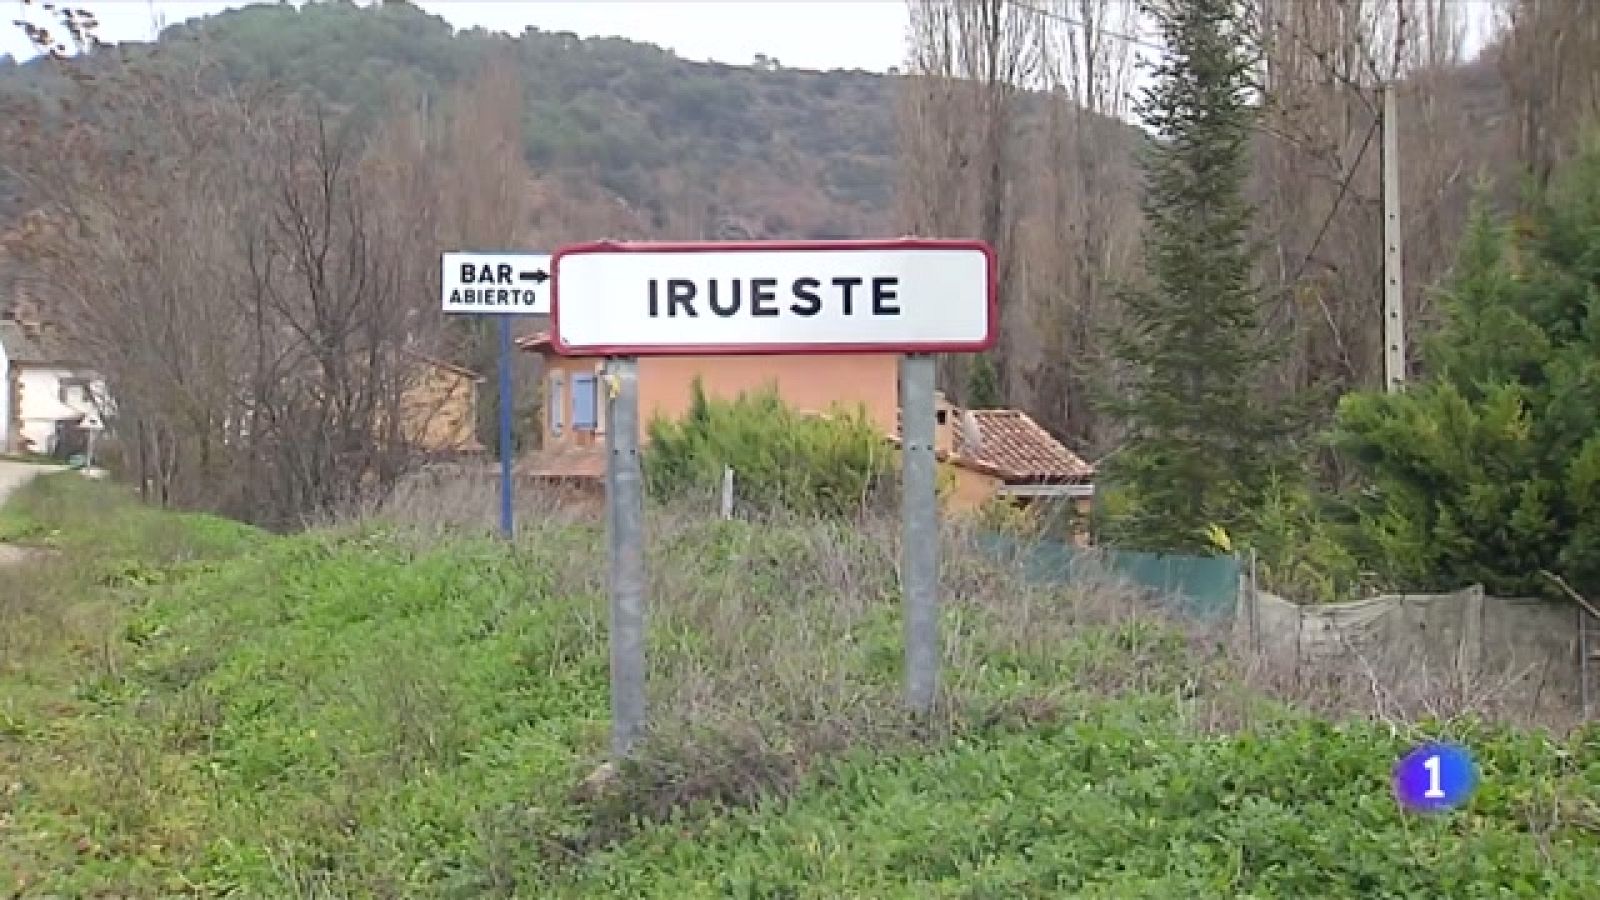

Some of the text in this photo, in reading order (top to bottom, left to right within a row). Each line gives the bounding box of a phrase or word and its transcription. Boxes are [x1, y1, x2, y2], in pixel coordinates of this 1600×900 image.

[460, 264, 513, 284] BAR
[449, 288, 536, 306] ABIERTO
[647, 276, 902, 318] IRUESTE
